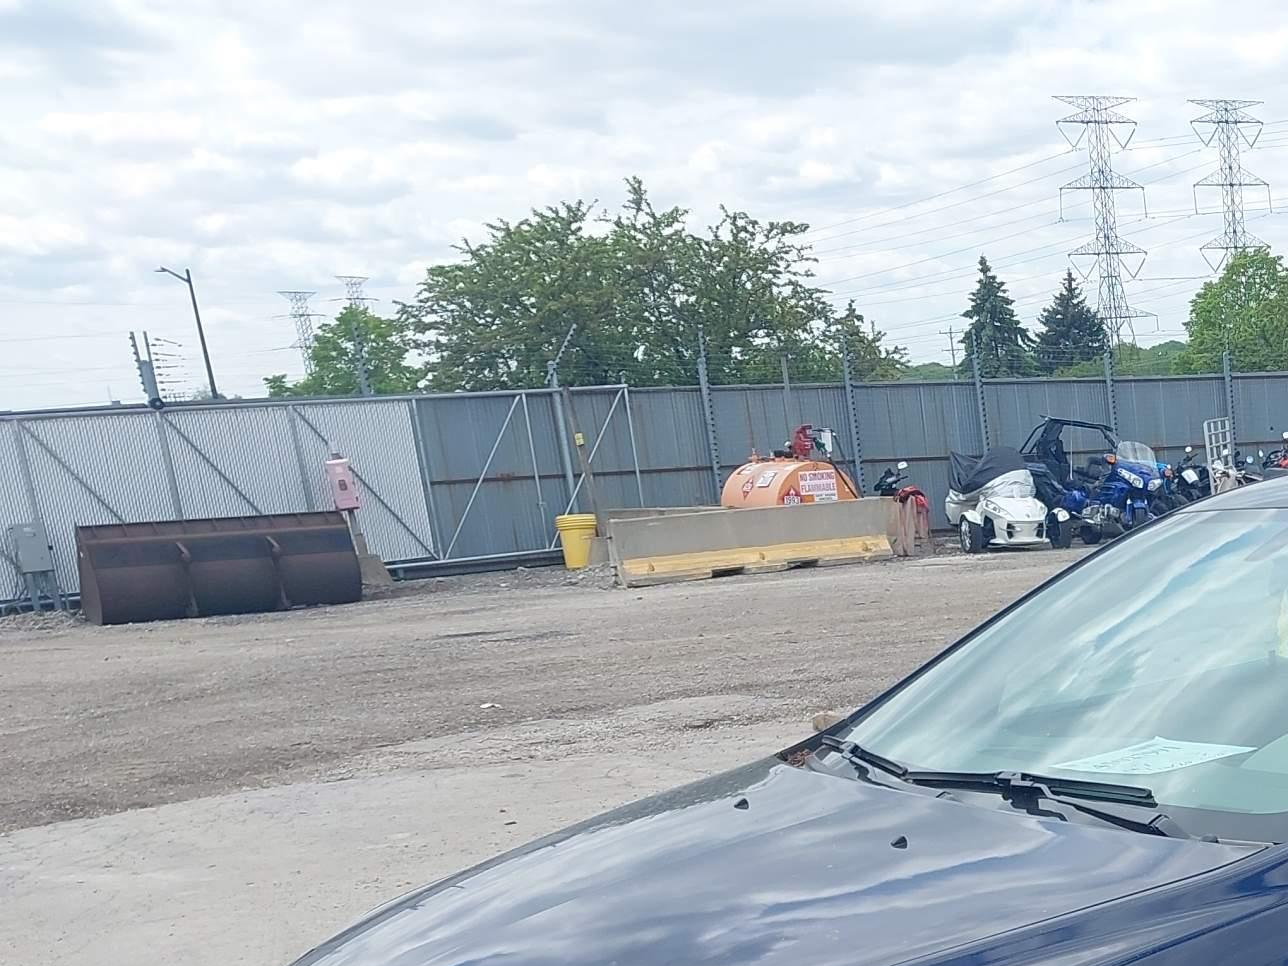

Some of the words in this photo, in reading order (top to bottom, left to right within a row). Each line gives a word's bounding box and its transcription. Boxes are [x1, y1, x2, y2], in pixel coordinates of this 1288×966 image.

[800, 473, 808, 481] NO
[808, 471, 835, 481] SMOKING
[801, 482, 836, 493] FLAMMABLE
